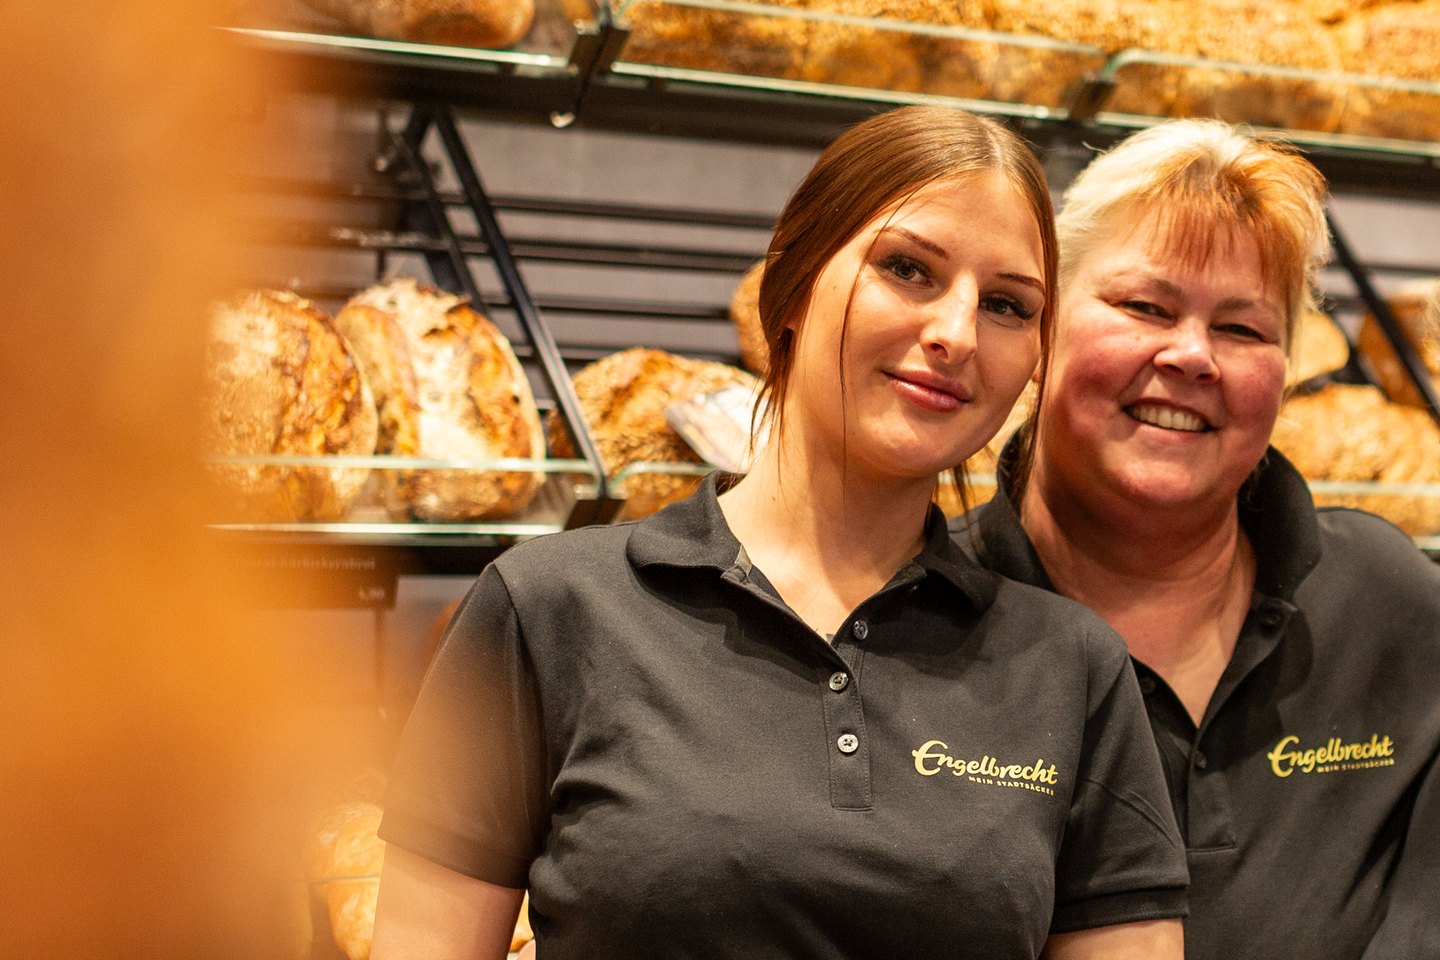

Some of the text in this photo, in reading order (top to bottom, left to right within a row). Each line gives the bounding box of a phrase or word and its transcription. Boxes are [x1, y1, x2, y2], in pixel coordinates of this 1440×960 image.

[911, 740, 1059, 785] Engelbrecht
[1267, 733, 1394, 778] Engelbrecht
[968, 776, 994, 785] MEIN
